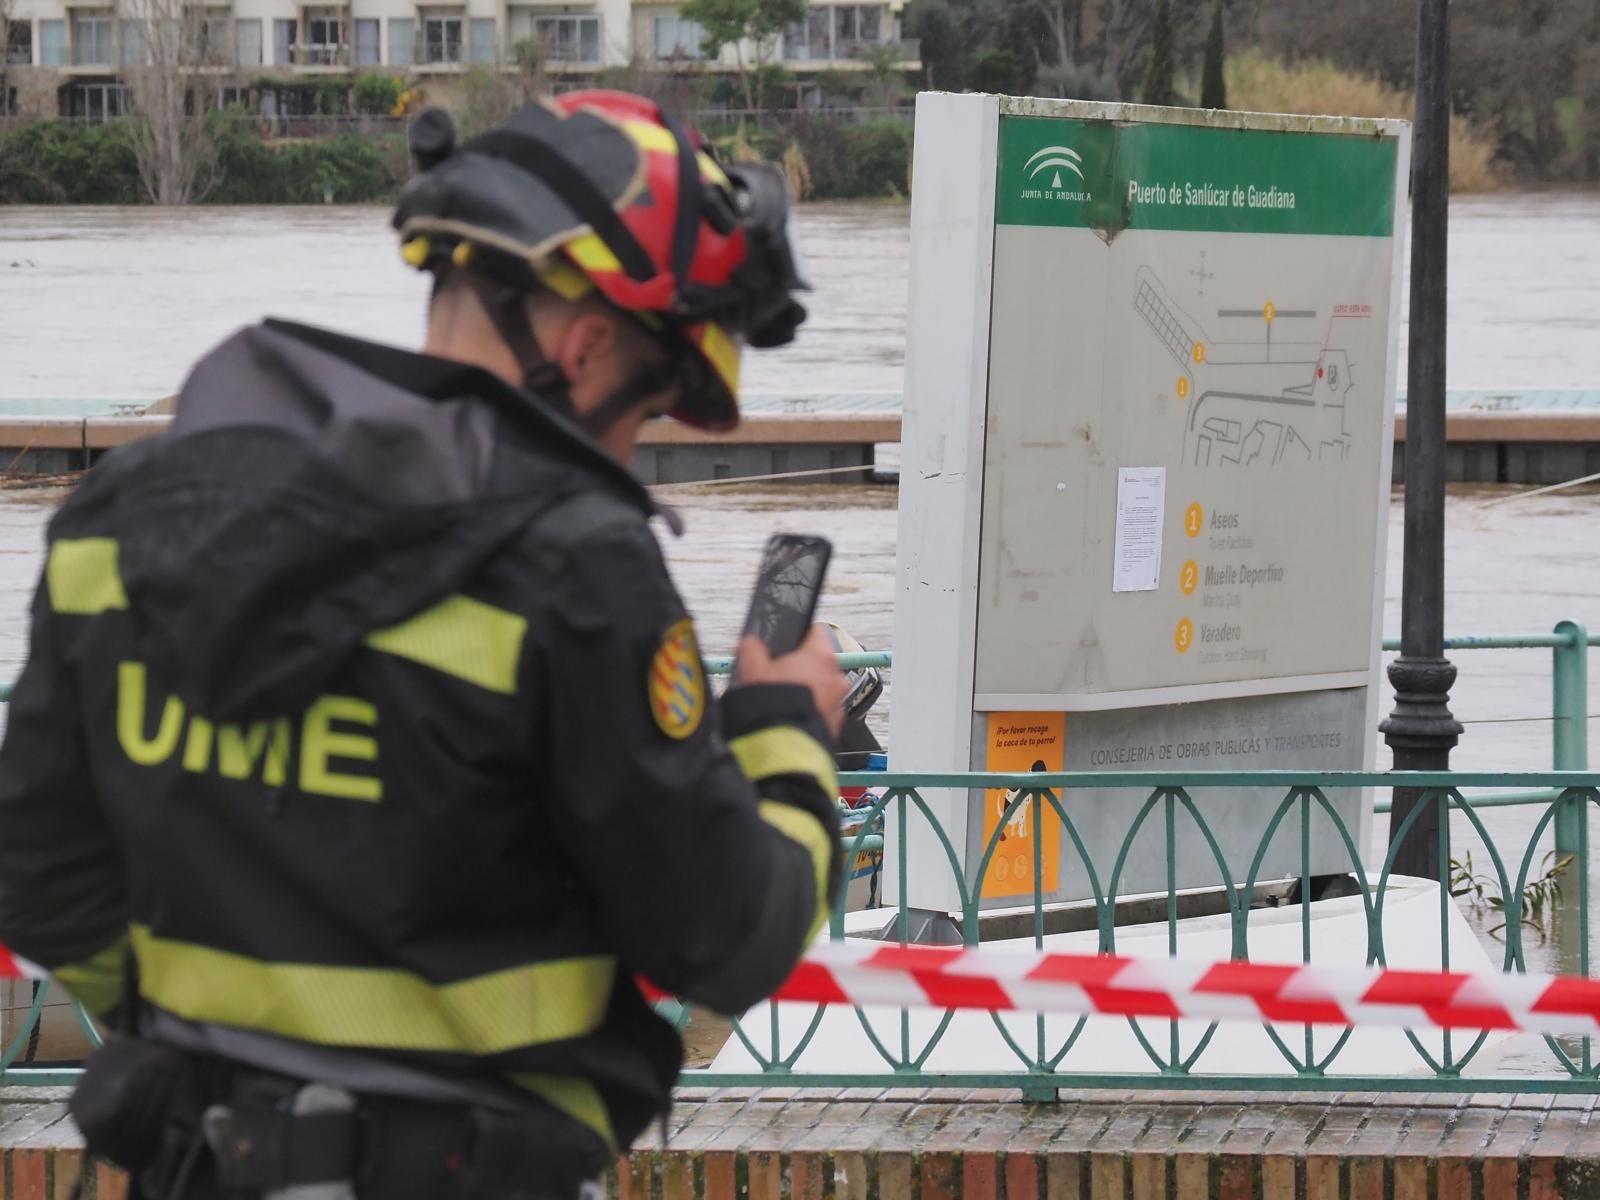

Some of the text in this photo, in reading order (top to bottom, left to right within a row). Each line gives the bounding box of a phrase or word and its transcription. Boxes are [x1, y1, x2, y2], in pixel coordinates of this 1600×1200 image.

[1020, 189, 1092, 201] JUNTA DE ANDALUCA
[1128, 180, 1296, 209] Puerto de Sanlúcar de Guadiana
[1209, 509, 1239, 529] Aseos
[1204, 564, 1237, 586] Muelle
[1239, 563, 1284, 589] Deportivo
[1200, 621, 1241, 643] Varadero
[116, 660, 384, 803] UME
[1010, 725, 1026, 735] favor
[1019, 737, 1028, 747] de
[1158, 744, 1173, 761] DE
[1176, 740, 1211, 761] OBRAS
[1265, 737, 1272, 753] Y
